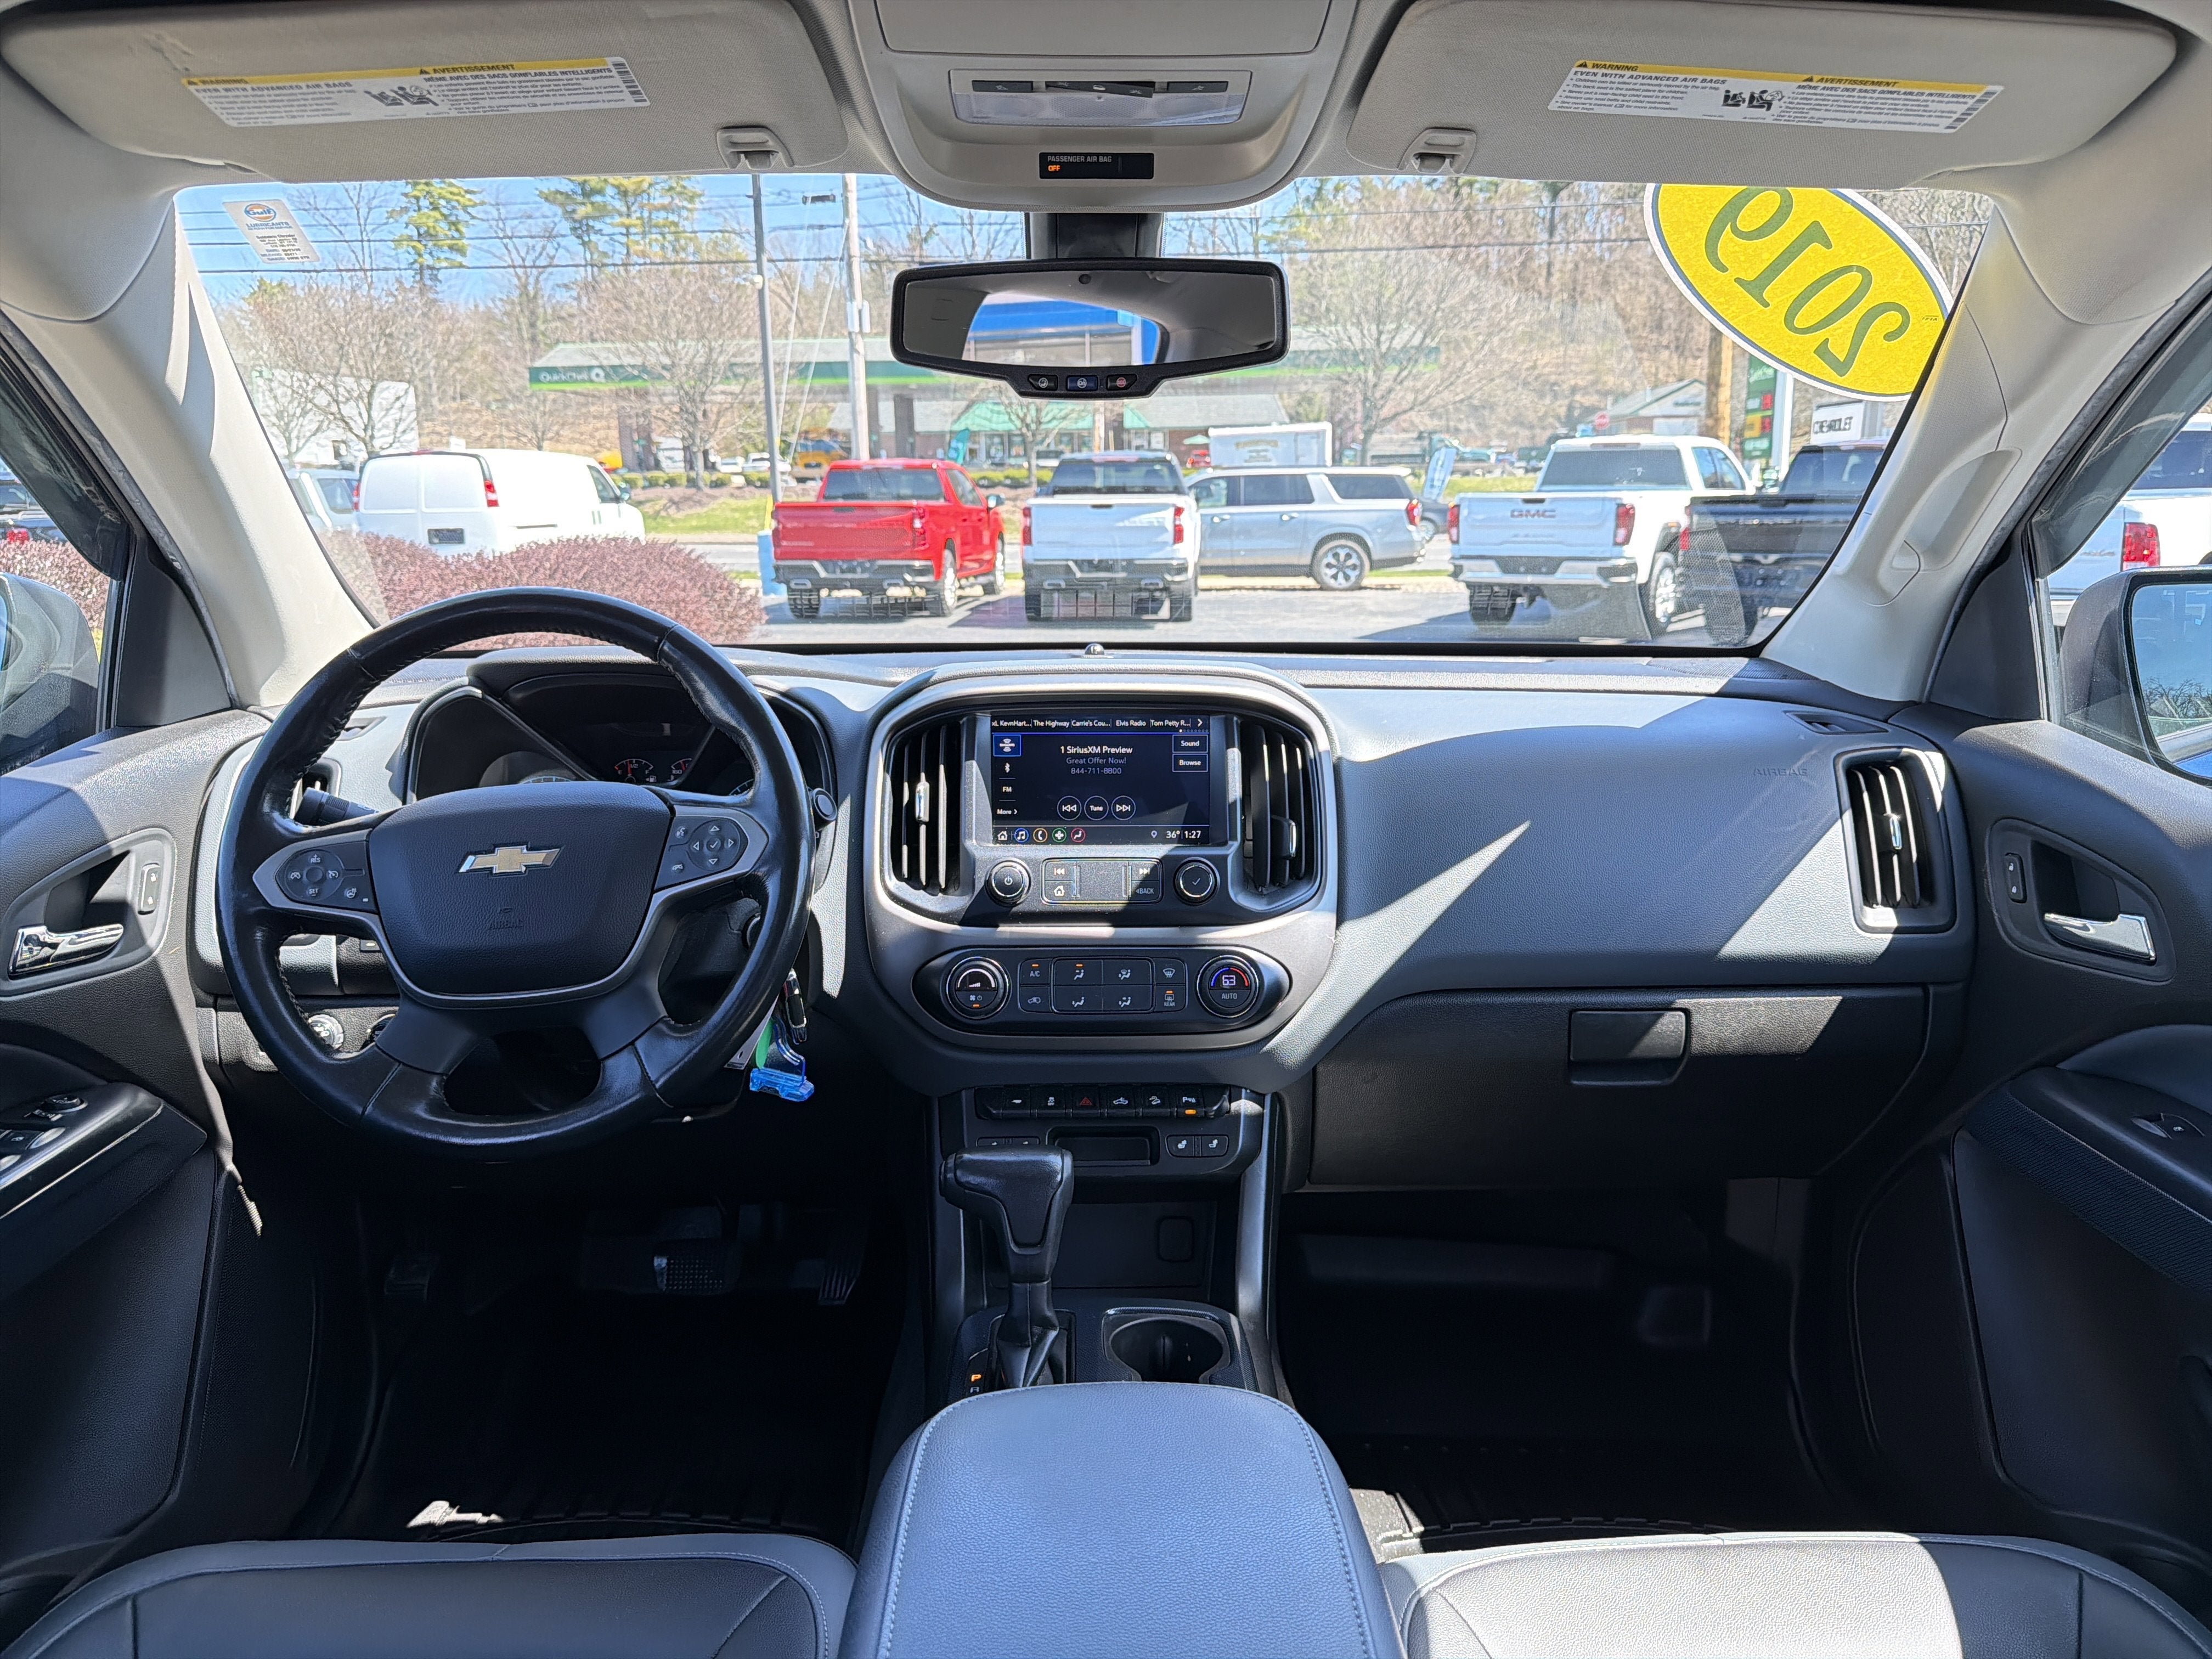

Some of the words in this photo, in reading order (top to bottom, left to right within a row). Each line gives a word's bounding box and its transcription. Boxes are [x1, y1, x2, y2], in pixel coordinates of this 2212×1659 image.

[432, 65, 515, 73] AVERTISSEMENT
[1817, 77, 1898, 86] AVERTISSEMENT
[1510, 509, 1556, 518] GMC
[1222, 975, 1235, 986] 63
[970, 1374, 982, 1383] P
